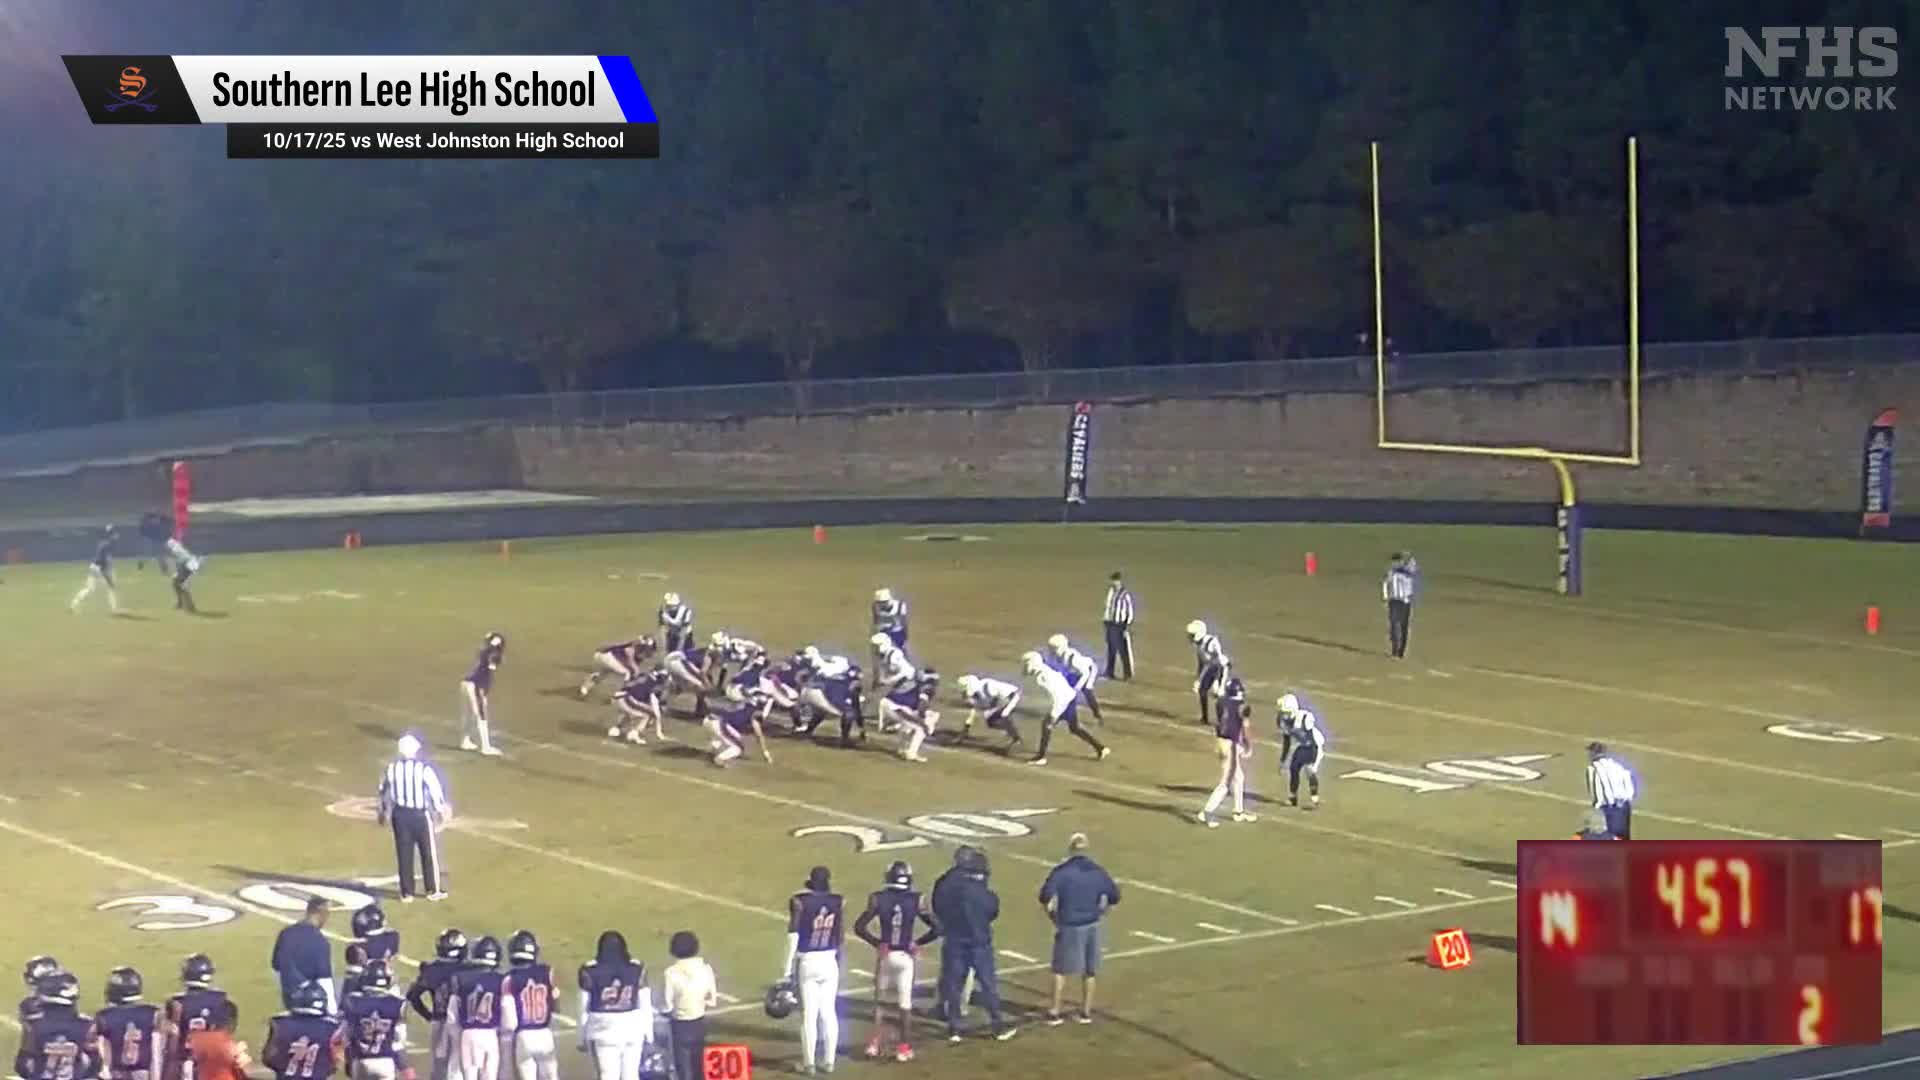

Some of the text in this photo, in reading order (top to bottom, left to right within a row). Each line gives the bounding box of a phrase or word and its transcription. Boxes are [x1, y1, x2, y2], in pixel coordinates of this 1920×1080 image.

[96, 882, 375, 930] 30
[1441, 933, 1466, 963] 20
[1798, 984, 1822, 1045] 2
[707, 1050, 743, 1080] 30
